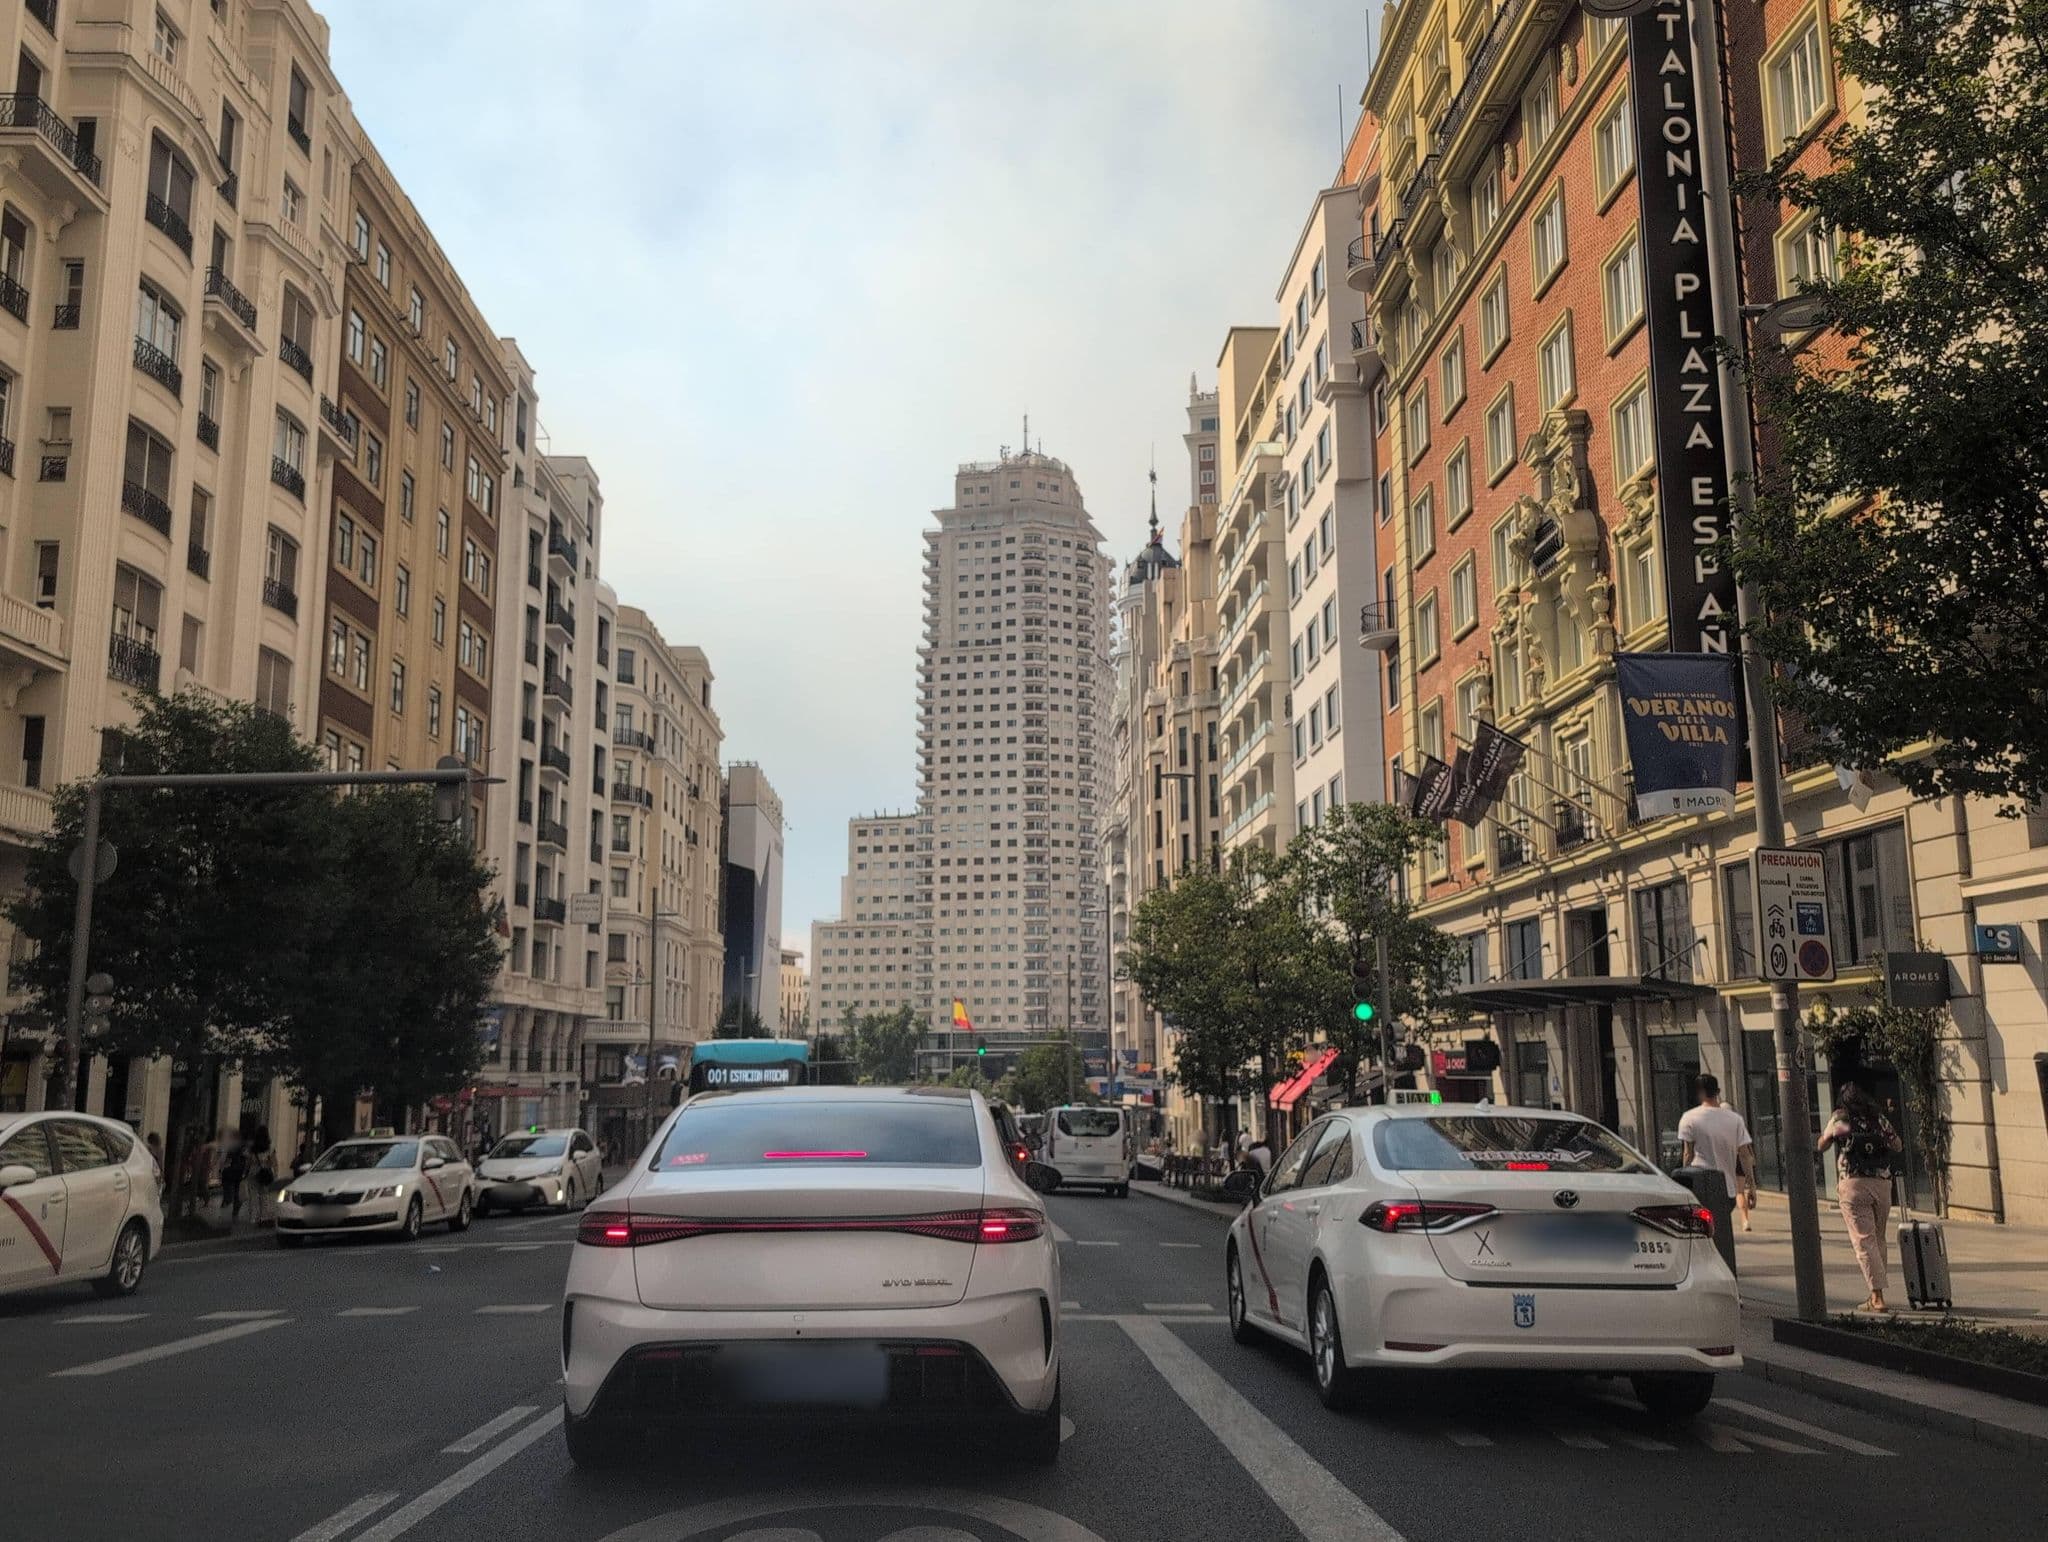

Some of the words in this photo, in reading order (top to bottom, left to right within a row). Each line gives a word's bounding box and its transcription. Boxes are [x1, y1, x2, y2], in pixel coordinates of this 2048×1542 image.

[1674, 272, 1714, 449] PLAZA
[1627, 697, 1736, 719] VERANOS
[1677, 716, 1692, 724] DE
[1693, 716, 1706, 724] LA
[1657, 721, 1729, 745] VILLA
[1761, 854, 1821, 868] PRECAUCIÓN
[1774, 951, 1784, 969] 30
[1894, 972, 1941, 982] AROMES
[708, 1068, 728, 1084] 001
[729, 1069, 763, 1083] ESTACION
[764, 1069, 789, 1082] ATOCHA
